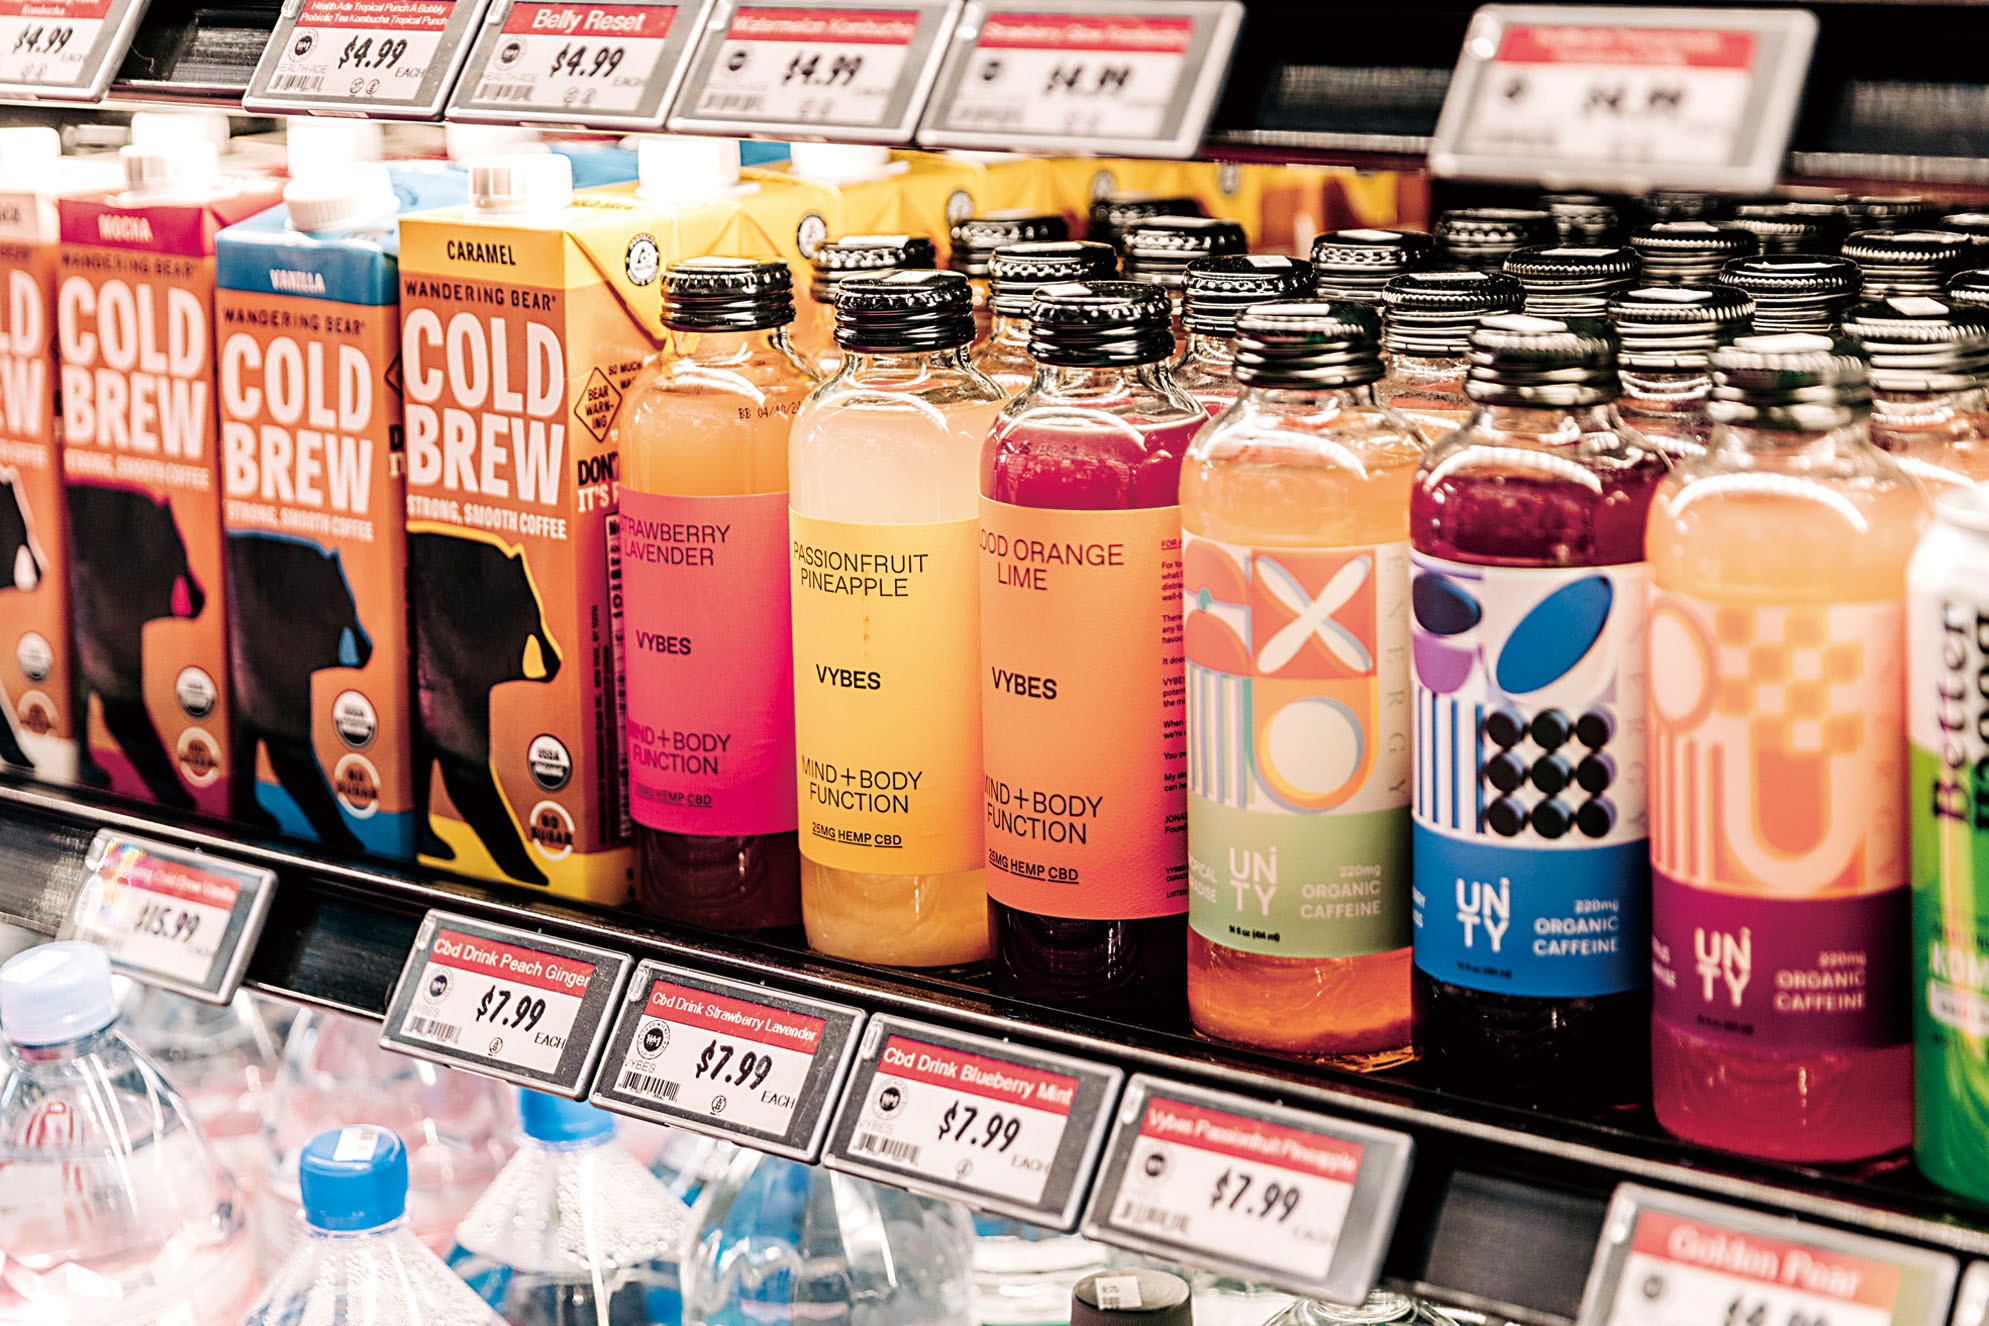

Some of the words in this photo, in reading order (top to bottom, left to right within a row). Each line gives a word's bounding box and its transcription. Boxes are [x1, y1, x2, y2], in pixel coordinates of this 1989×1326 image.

[300, 12, 334, 22] Probiotic
[334, 13, 349, 23] Tea
[349, 14, 389, 24] Kombucha
[390, 15, 421, 26] Tropical
[422, 16, 448, 26] Punch
[311, 1, 337, 11] Health
[337, 2, 353, 12] Ade
[354, 2, 383, 13] Tropical
[384, 3, 408, 13] Punch
[408, 4, 417, 13] A
[418, 4, 446, 15] Bubbly
[532, 9, 584, 33] Belly
[584, 10, 646, 30] Reset
[12, 23, 73, 54] $4.99
[338, 35, 407, 69] $4.99
[394, 66, 425, 79] EACH
[550, 43, 624, 78] $4.99
[784, 52, 863, 85] $4.99
[98, 213, 153, 242] MOCHA
[447, 240, 516, 266] CARAMEL
[270, 269, 325, 293] VANILLA
[405, 280, 504, 306] WANDERING
[58, 275, 206, 380] COLD
[223, 307, 320, 331] WANDERING
[403, 308, 565, 418] COLD
[608, 365, 618, 375] SO
[620, 361, 642, 373] MUCH
[222, 333, 373, 433] COLD
[588, 385, 609, 401] BEAR
[61, 364, 207, 461] BREW
[585, 401, 615, 416] WARN-
[592, 415, 607, 430] ING
[223, 420, 374, 513] BREW
[405, 403, 566, 507] BREW
[164, 461, 210, 491] COFFEE
[578, 483, 610, 512] IT'S
[227, 500, 279, 527] STRONG,
[280, 506, 329, 533] SMOOTH
[331, 514, 374, 542] COFFEE
[406, 493, 463, 524] STRONG,
[464, 502, 518, 531] SMOOTH
[519, 512, 567, 540] COFFEE
[624, 538, 714, 565] LAVENDER
[793, 541, 929, 574] PASSIONFRUIT
[1014, 538, 1125, 566] ORANGE
[1161, 540, 1177, 551] FOR
[998, 561, 1048, 591] LIME
[1162, 561, 1174, 569] For
[1162, 570, 1179, 580] what
[801, 567, 909, 597] PINEAPPLE
[636, 629, 691, 656] VYBES
[1162, 624, 1175, 634] any
[1163, 657, 1169, 665] It
[815, 663, 881, 691] VYBES
[991, 666, 1058, 700] VYBES
[1163, 699, 1175, 708] the
[1931, 600, 1968, 823] Better
[1164, 719, 1184, 728] When
[1164, 730, 1182, 740] we're
[633, 743, 718, 775] FUNCTION
[1164, 752, 1177, 761] You
[1164, 783, 1177, 792] can
[1165, 772, 1176, 783] My
[687, 793, 713, 808] CBD
[810, 781, 909, 814] FUNCTION
[531, 827, 573, 845] SUGAR
[812, 821, 836, 841] 25MG
[838, 829, 872, 846] HEMP
[874, 834, 903, 848] CBD
[986, 802, 1087, 845] FUNCTION
[1010, 858, 1046, 881] HEMP
[1047, 866, 1079, 884] CBD
[1339, 864, 1381, 877] 220mg
[1301, 880, 1382, 899] ORGANIC
[1299, 901, 1382, 920] CAFFEINE
[1574, 899, 1620, 914] 220mg
[1533, 916, 1620, 936] ORGANIC
[1532, 937, 1620, 956] CAFFEINE
[433, 938, 463, 958] Cbd
[462, 945, 500, 966] Drink
[500, 953, 543, 977] Peach
[544, 963, 592, 989] Ginger
[1774, 968, 1867, 990] ORGANIC
[476, 985, 547, 1031] $7.99
[1772, 990, 1867, 1013] CAFFEINE
[652, 991, 675, 1008] Cbd
[675, 996, 705, 1016] Drink
[705, 1004, 765, 1031] Strawberry
[765, 1017, 817, 1041] Lavender
[534, 1032, 567, 1050] EACH
[696, 1039, 772, 1090] $7.99
[882, 1047, 917, 1069] Cbd
[916, 1053, 959, 1079] Drink
[959, 1063, 1035, 1100] Blueberry
[1035, 1080, 1076, 1106] Mint
[760, 1090, 796, 1110] EACH
[938, 1100, 1021, 1152] $7.99
[1148, 1107, 1194, 1135] Vybes
[1281, 1137, 1358, 1175] Pineapple
[1211, 1168, 1300, 1223] $7.99
[1667, 1222, 1780, 1284] Golden
